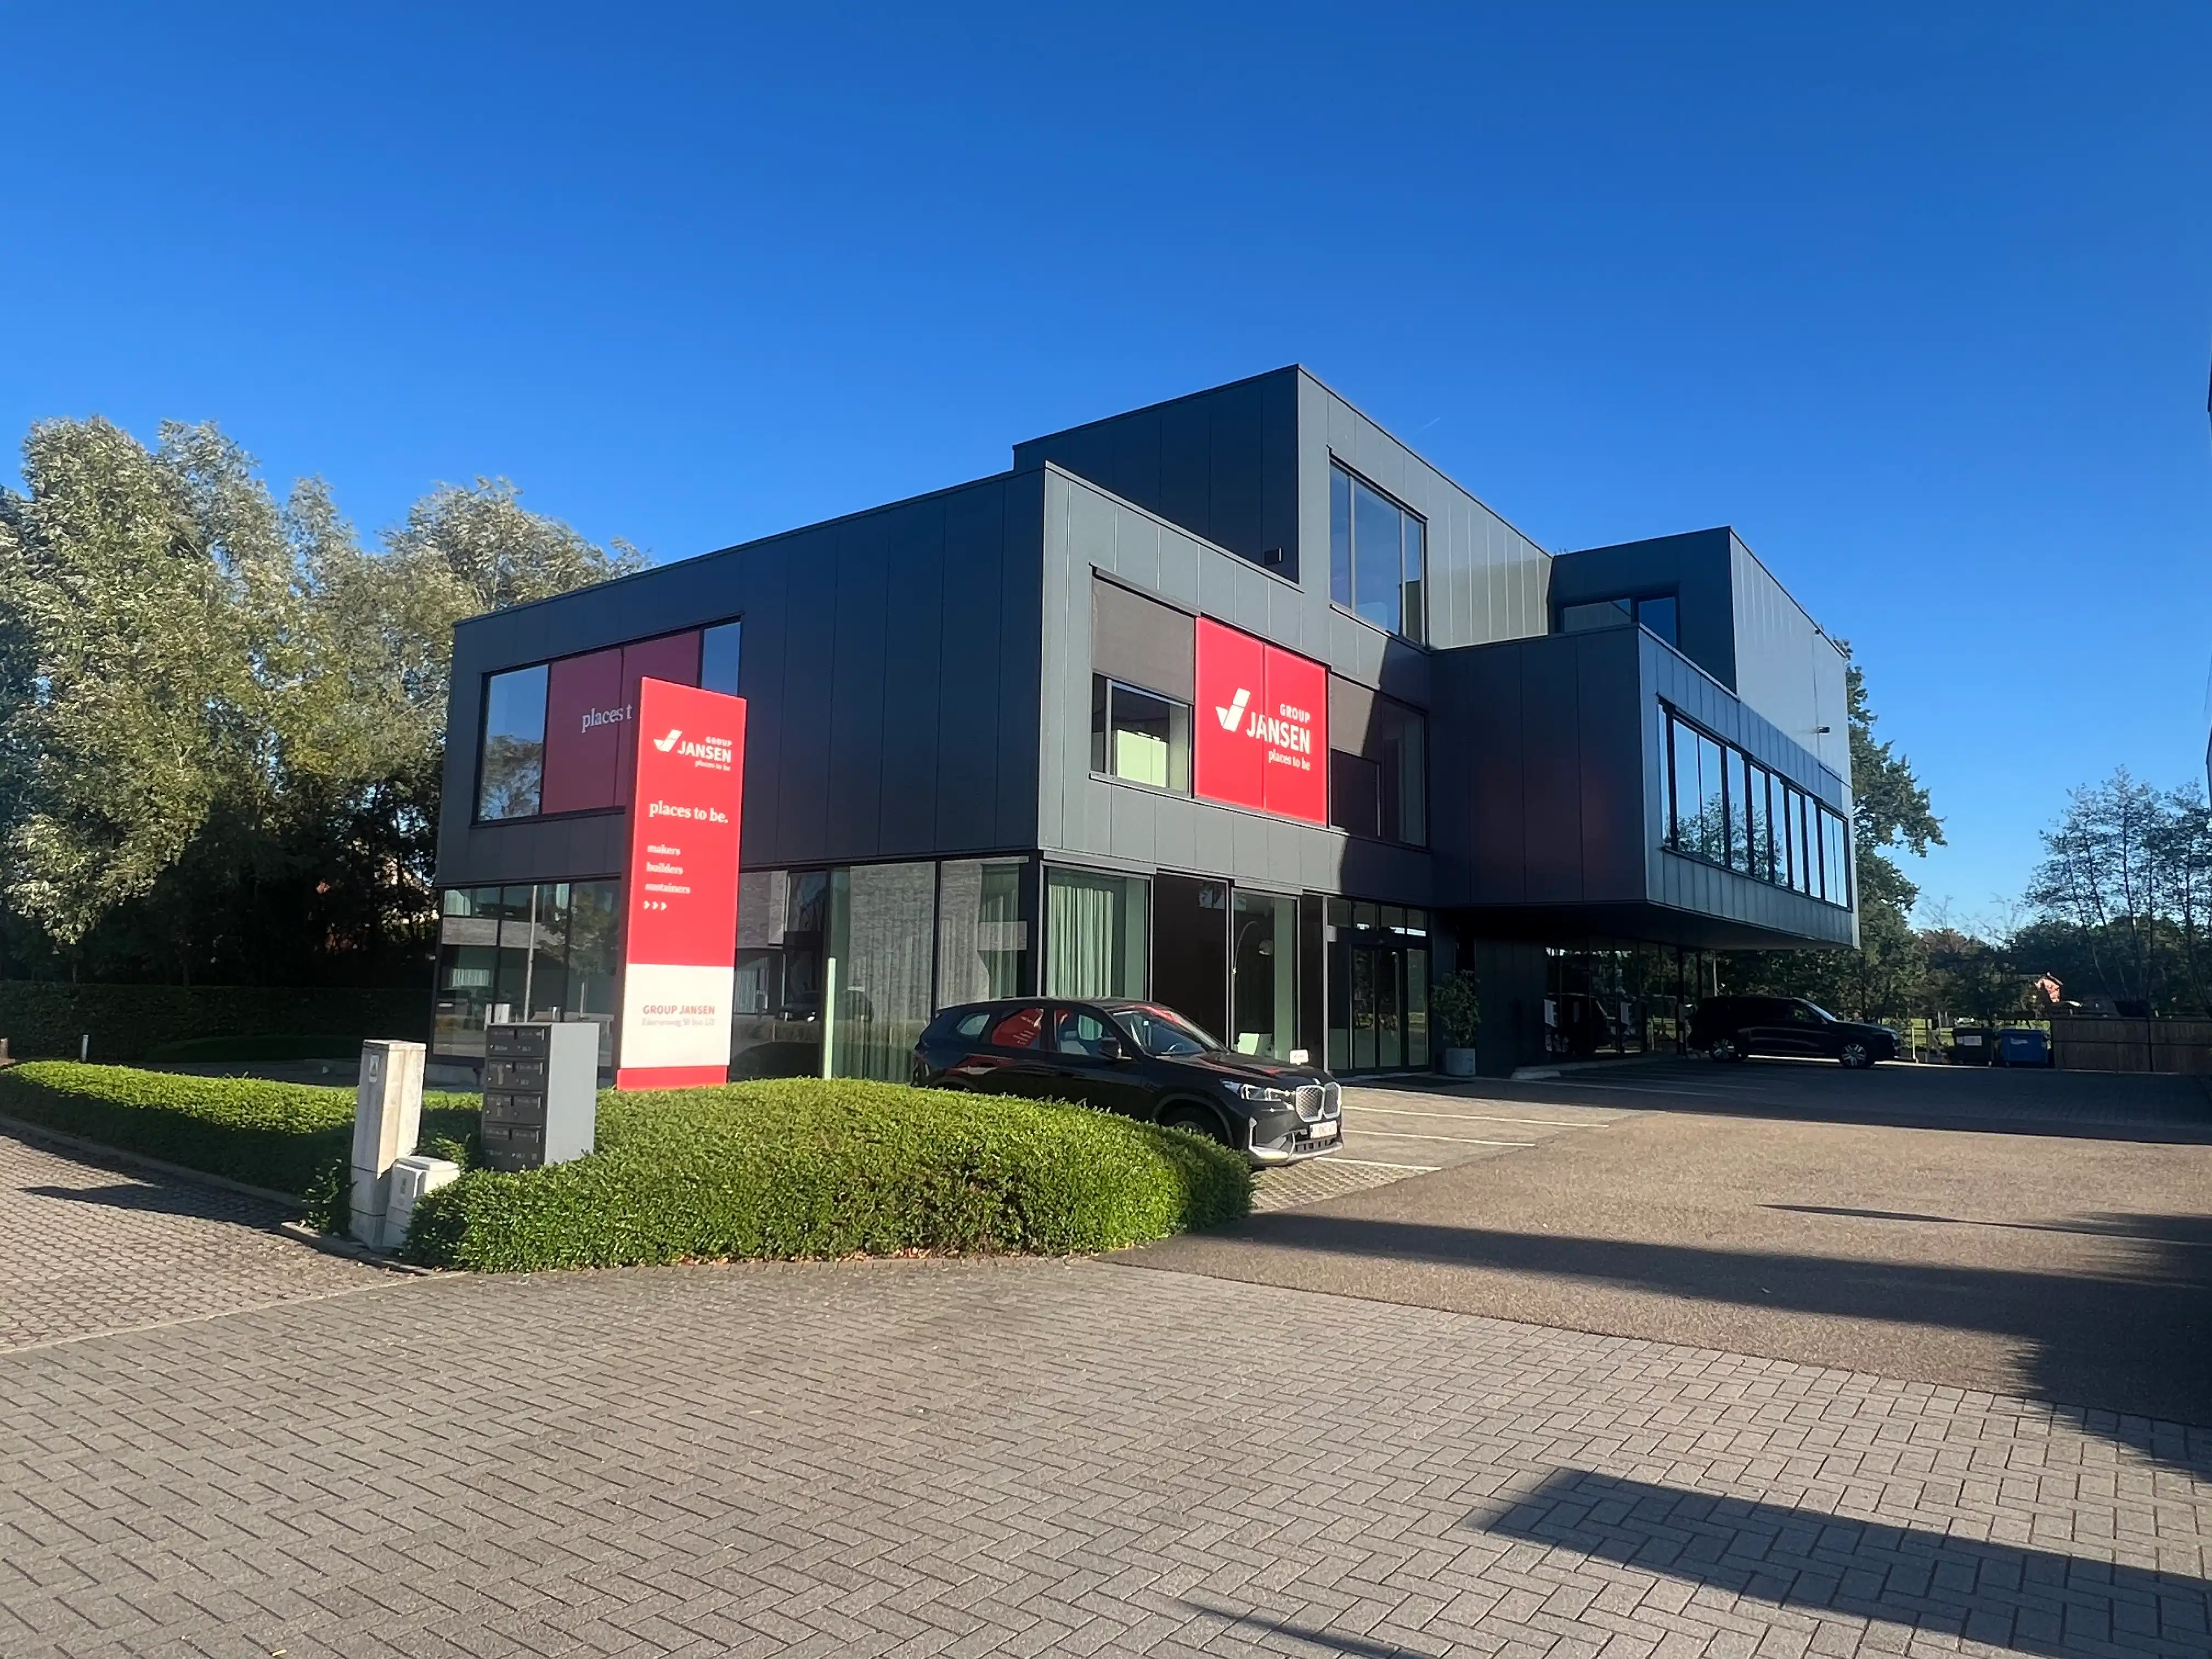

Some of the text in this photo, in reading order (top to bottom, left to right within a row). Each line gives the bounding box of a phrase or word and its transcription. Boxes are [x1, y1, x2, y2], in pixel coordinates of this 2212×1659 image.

[582, 703, 633, 733] places t
[1279, 703, 1310, 724] GROUP
[1246, 711, 1310, 755] JANSEN
[678, 741, 732, 763] JANSEN
[1268, 748, 1311, 771] places to be
[649, 800, 729, 823] places to be.
[647, 844, 681, 856] makers
[646, 861, 684, 875] builders
[642, 1005, 715, 1015] GROUP JANSEN
